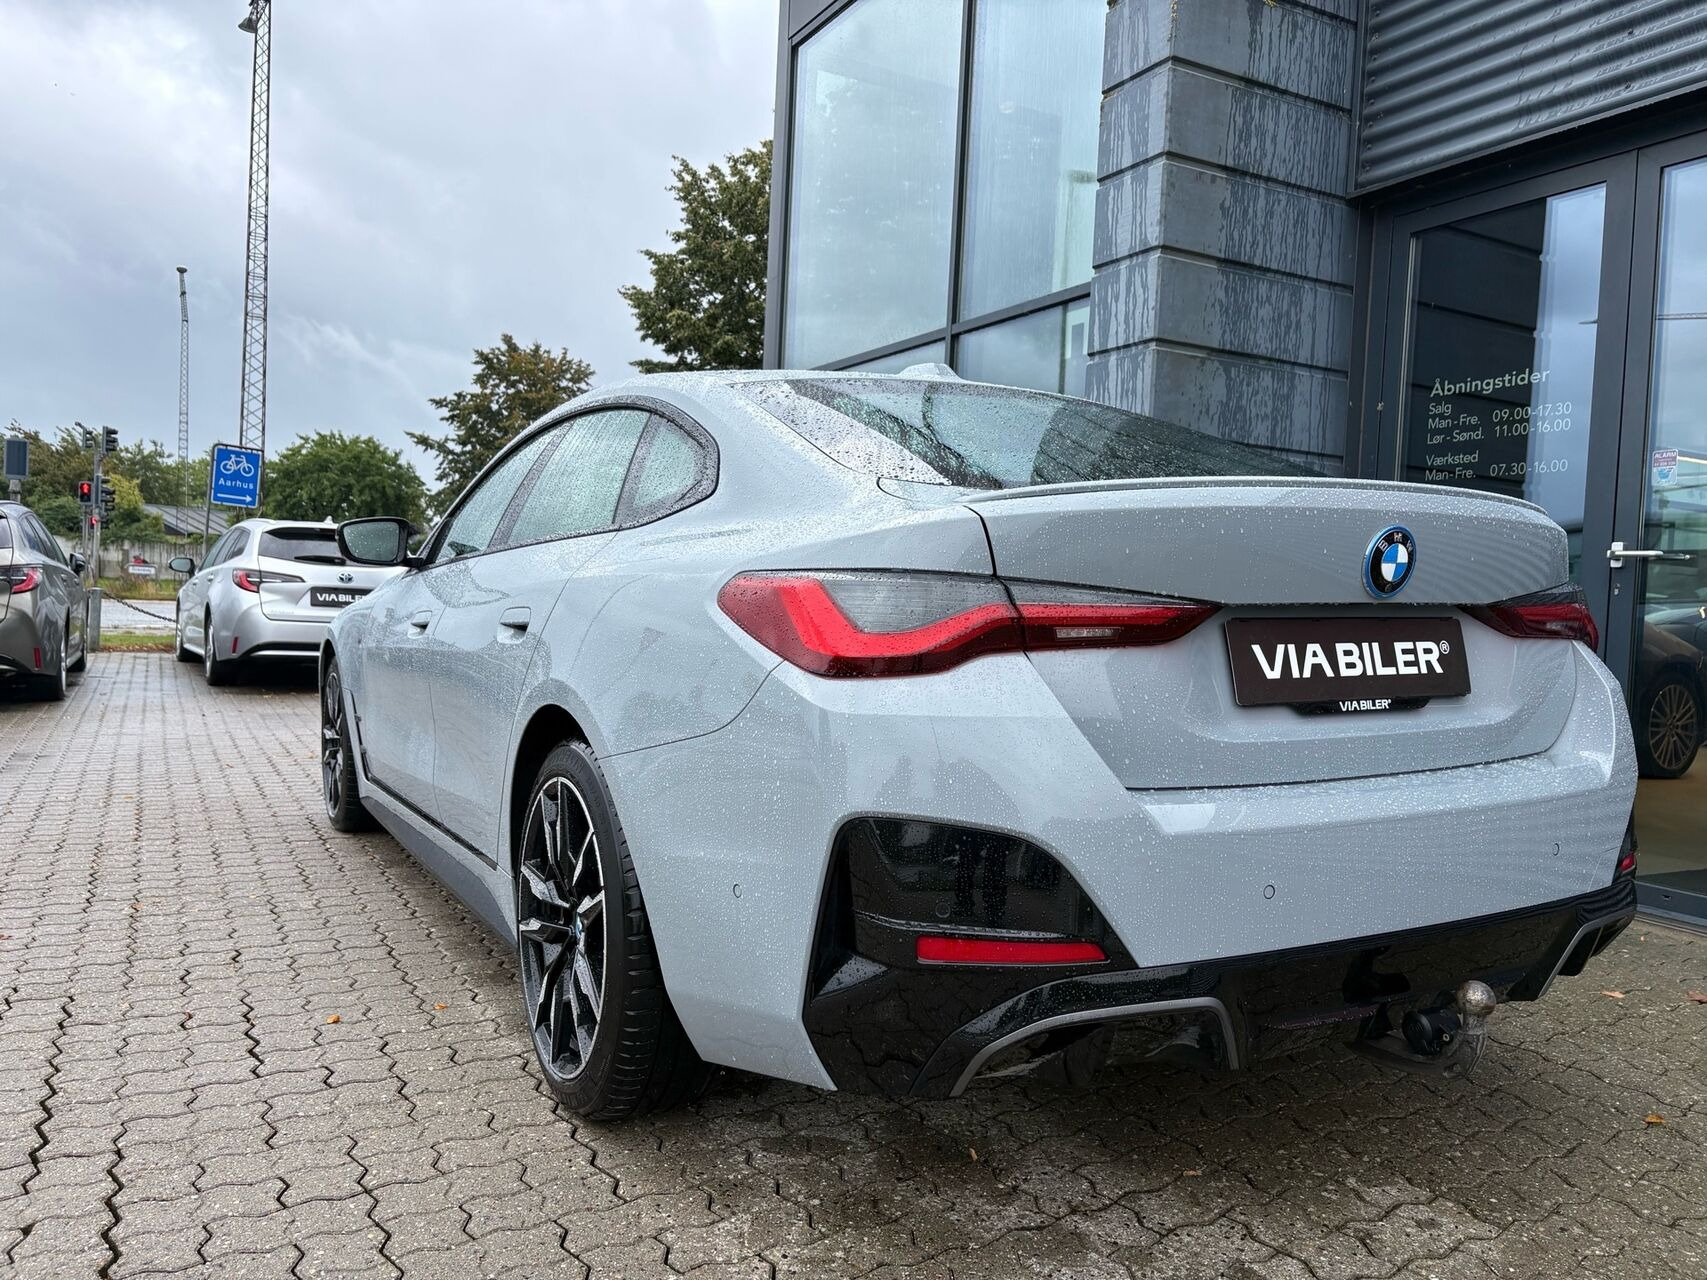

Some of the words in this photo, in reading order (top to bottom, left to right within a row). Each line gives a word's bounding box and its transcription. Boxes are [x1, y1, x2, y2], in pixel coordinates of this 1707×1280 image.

[1430, 368, 1550, 398] Åbningstider
[1428, 401, 1452, 416] Salg
[1426, 449, 1479, 466] Værksted
[218, 477, 254, 489] Aarhus
